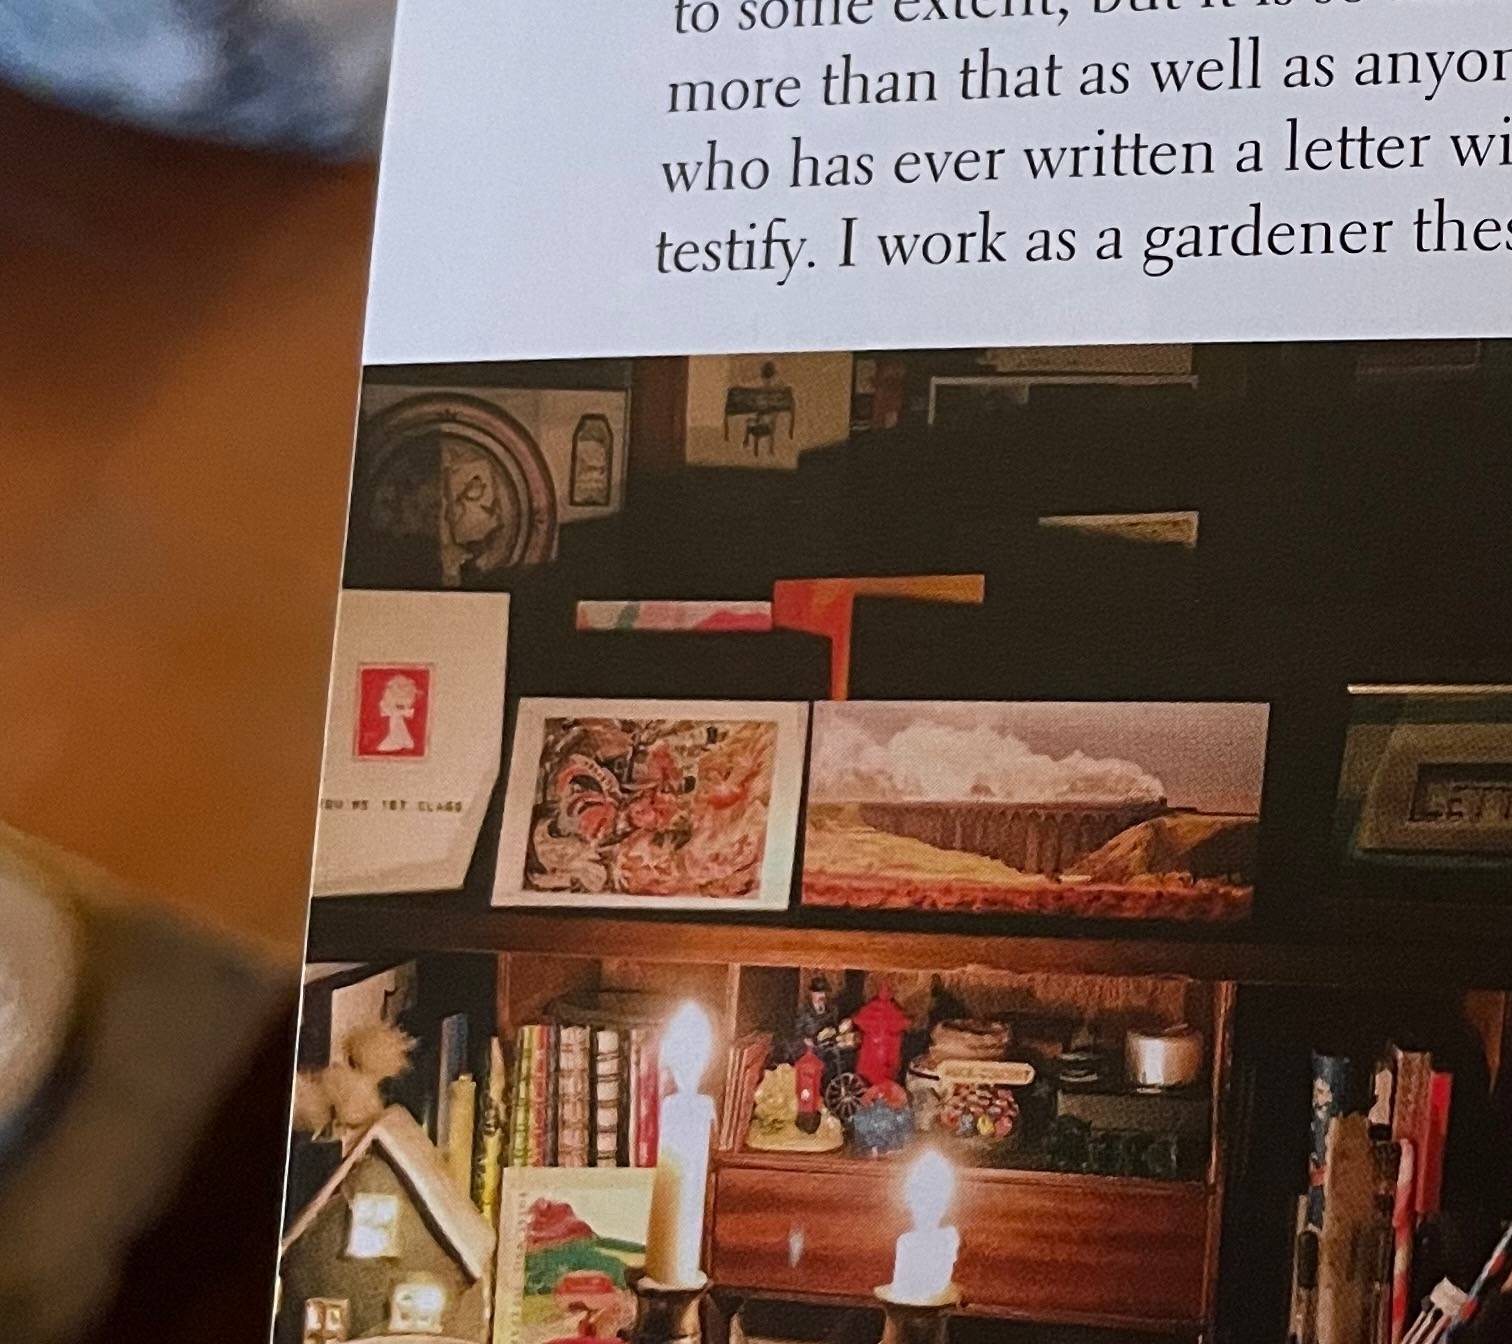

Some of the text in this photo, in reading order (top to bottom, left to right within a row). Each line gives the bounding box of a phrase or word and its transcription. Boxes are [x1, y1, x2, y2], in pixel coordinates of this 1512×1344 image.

[667, 76, 801, 113] more
[821, 53, 937, 106] than
[959, 47, 1063, 100] that
[1079, 61, 1130, 96] as
[1149, 35, 1262, 93] well
[1283, 54, 1335, 88] as
[655, 217, 816, 287] testify.
[838, 216, 859, 267] I
[876, 210, 1007, 267] work
[1025, 228, 1076, 263] as
[1096, 227, 1123, 260] a
[1142, 201, 1394, 278] gardener
